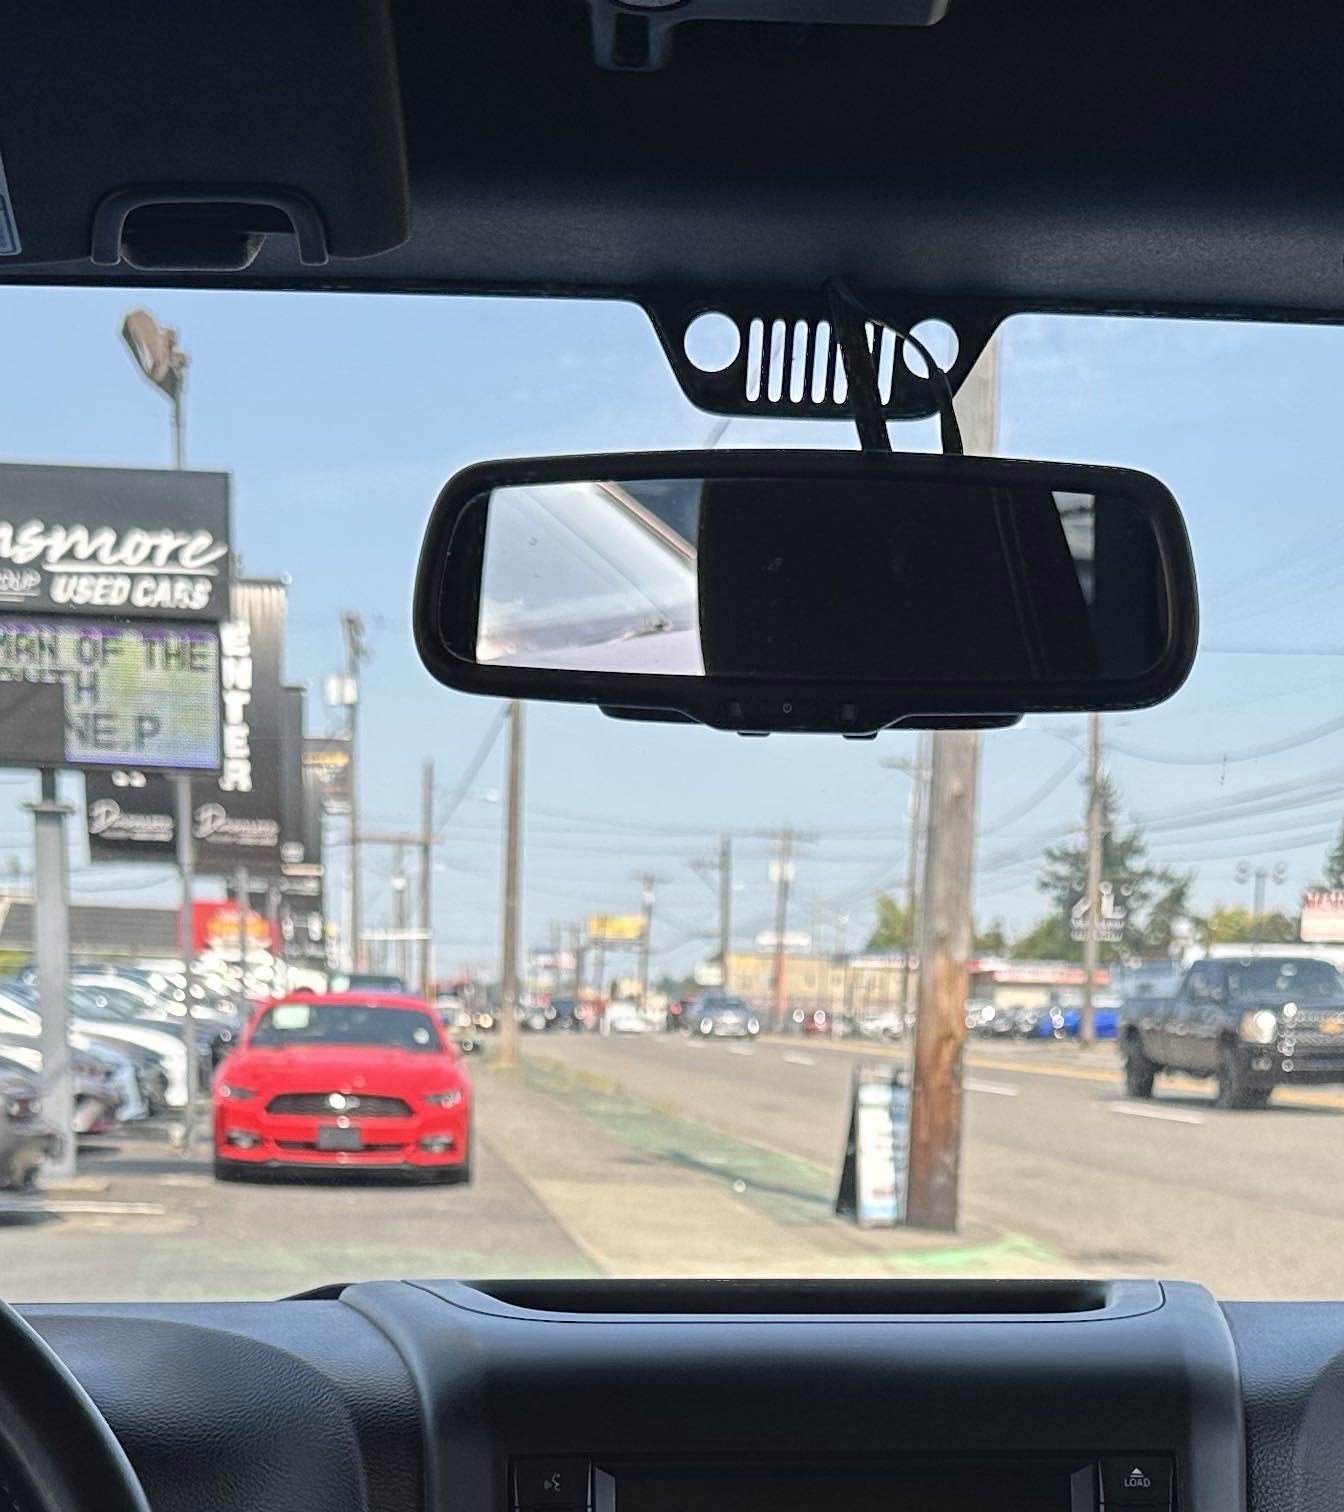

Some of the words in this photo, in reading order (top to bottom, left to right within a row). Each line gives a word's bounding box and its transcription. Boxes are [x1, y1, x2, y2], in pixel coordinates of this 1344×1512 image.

[49, 573, 130, 605] USED
[130, 575, 213, 610] CARS
[77, 634, 123, 664] OF
[143, 637, 212, 672] THE
[1124, 1478, 1151, 1488] LOAD
